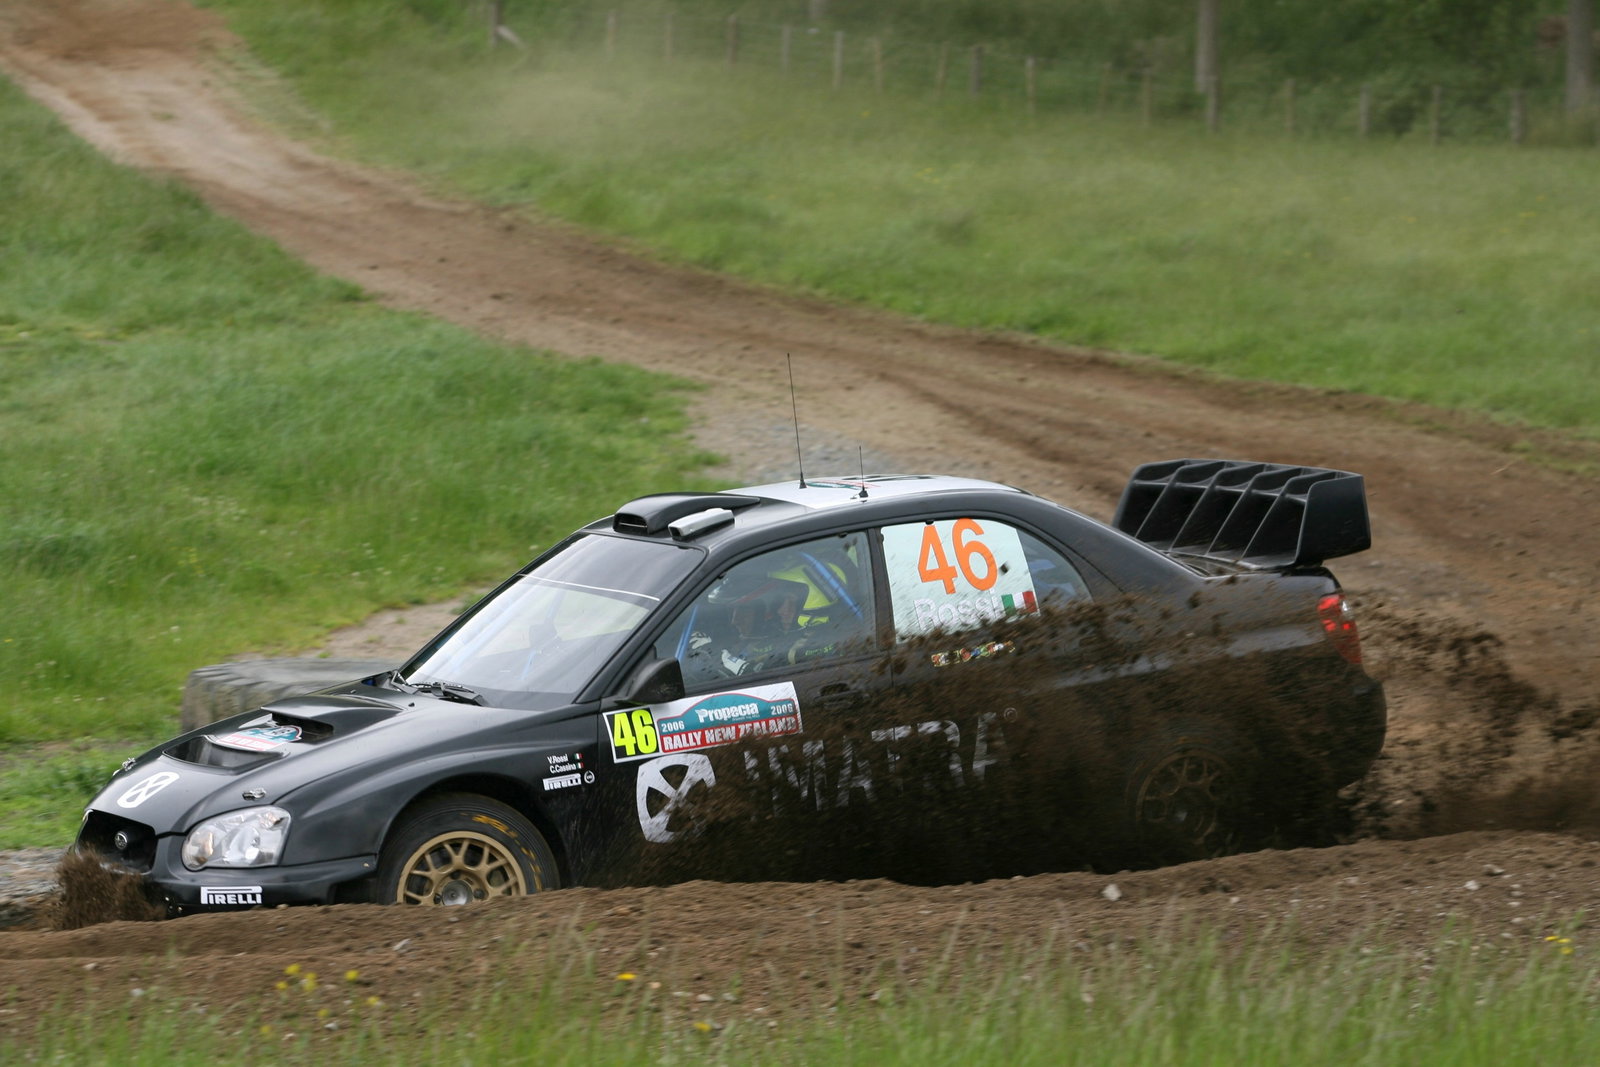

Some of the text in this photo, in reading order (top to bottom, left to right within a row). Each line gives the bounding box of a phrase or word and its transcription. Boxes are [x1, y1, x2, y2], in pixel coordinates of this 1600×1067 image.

[917, 517, 998, 595] 46
[914, 588, 1006, 632] Rossi
[695, 702, 760, 724] Propecia
[770, 703, 794, 716] 2006
[613, 709, 658, 756] 46
[661, 721, 685, 733] 2006
[663, 731, 703, 751] RALLY
[704, 725, 737, 743] NEW
[738, 716, 796, 738] ZEALAND
[542, 773, 582, 791] PIRELLI
[200, 886, 263, 905] PIRELLI
